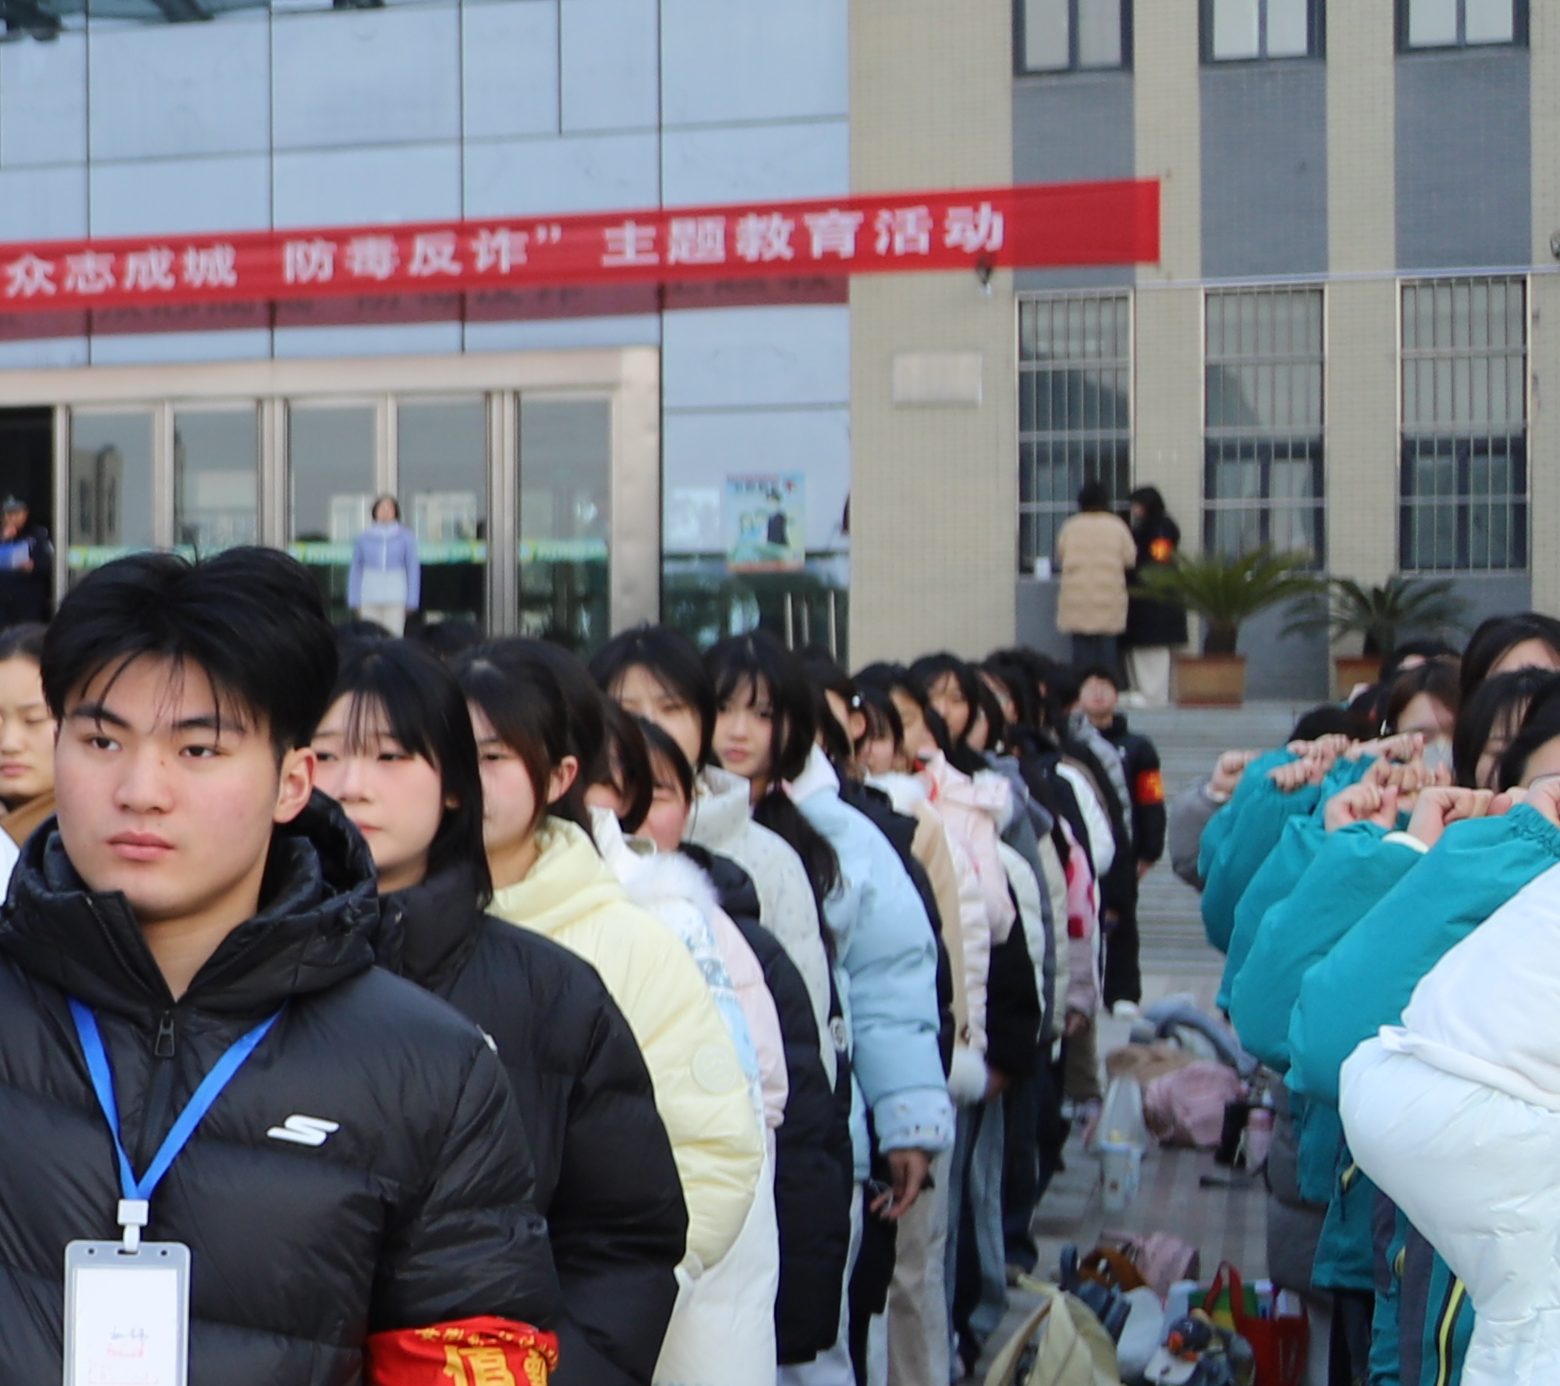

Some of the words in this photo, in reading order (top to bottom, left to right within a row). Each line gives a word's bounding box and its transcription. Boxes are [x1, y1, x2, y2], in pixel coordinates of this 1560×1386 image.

[601, 201, 1006, 268] 主题教育活动
